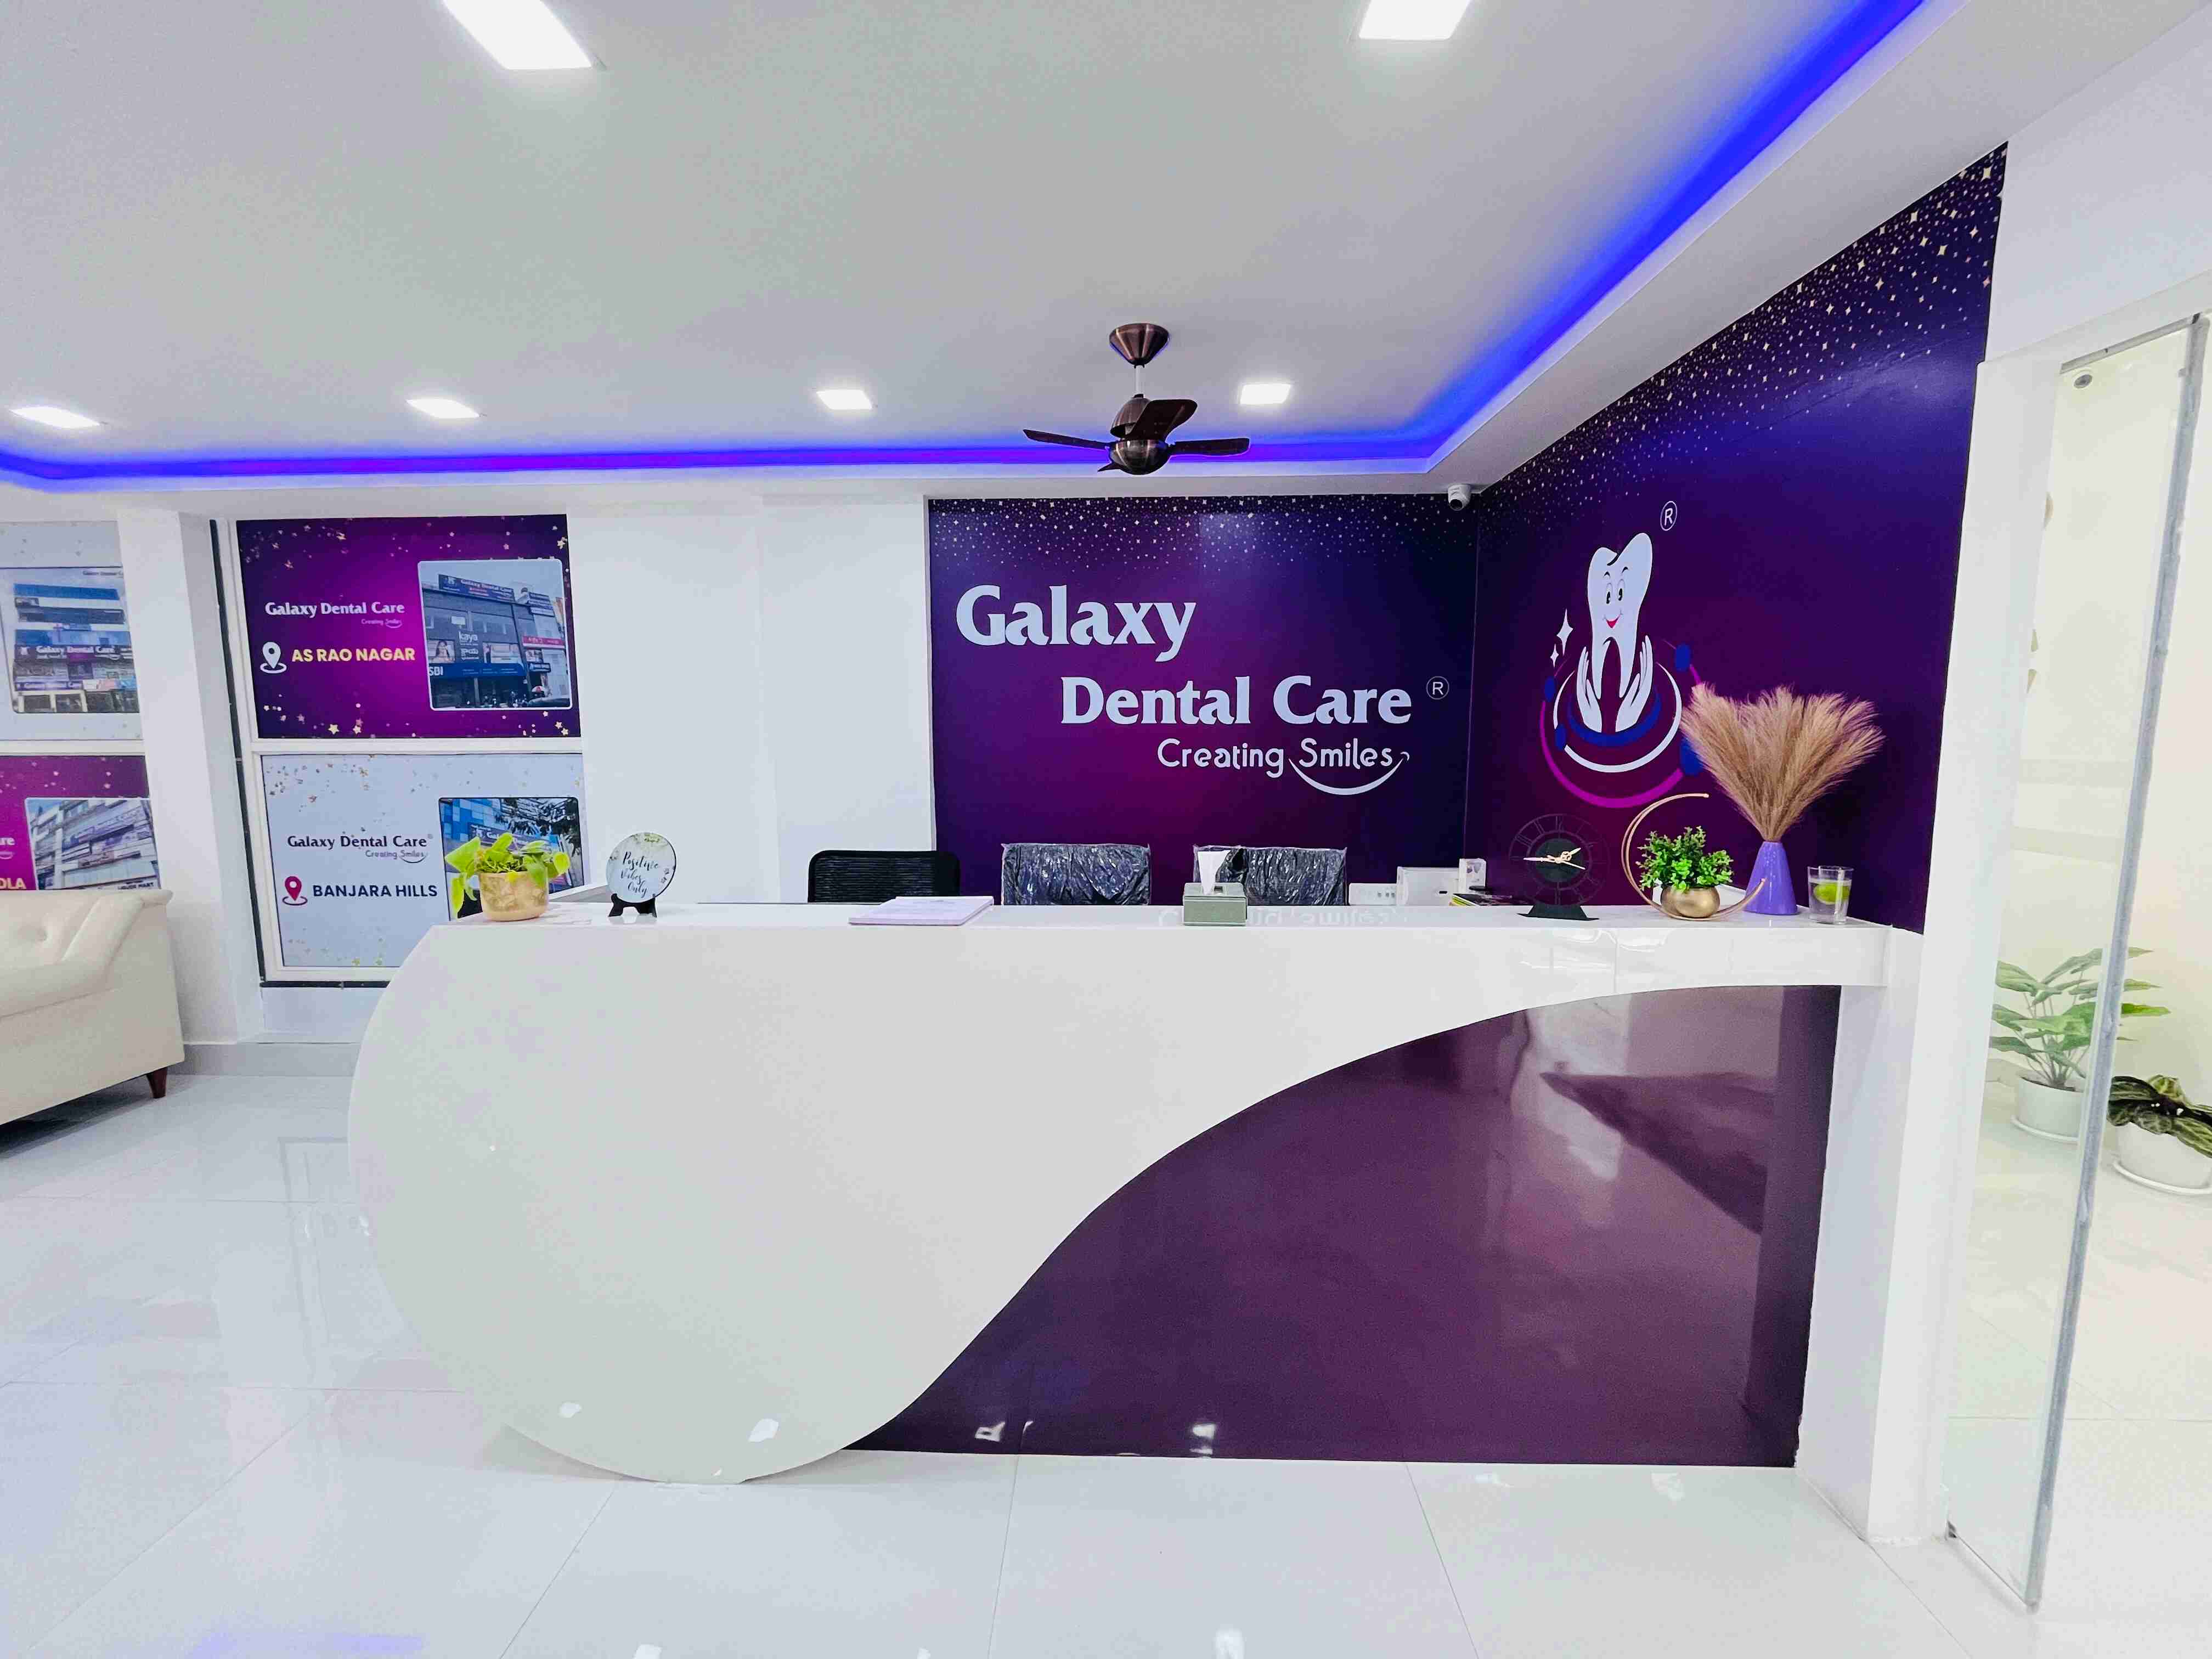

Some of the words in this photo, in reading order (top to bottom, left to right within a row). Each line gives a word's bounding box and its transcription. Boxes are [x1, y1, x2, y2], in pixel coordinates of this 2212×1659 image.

[265, 602, 317, 618] Galaxy
[320, 602, 367, 614] Dental
[371, 601, 405, 613] Care
[956, 585, 1197, 662] Galaxy
[292, 649, 313, 662] AS
[317, 648, 352, 662] RAO
[356, 648, 415, 661] NAGAR
[428, 666, 444, 676] SBI
[1061, 676, 1250, 725] Dental
[1273, 675, 1412, 724] Care
[1157, 738, 1284, 778] Creating
[1298, 737, 1393, 769] Smiles
[0, 837, 15, 845] re
[287, 836, 335, 850] Galaxy
[340, 836, 387, 847] Dental
[393, 836, 427, 847] Care
[365, 850, 397, 859] Creating
[622, 851, 658, 871] Positive
[313, 885, 392, 897] BANJARA
[396, 885, 438, 897] HILLS
[628, 879, 647, 898] Only
